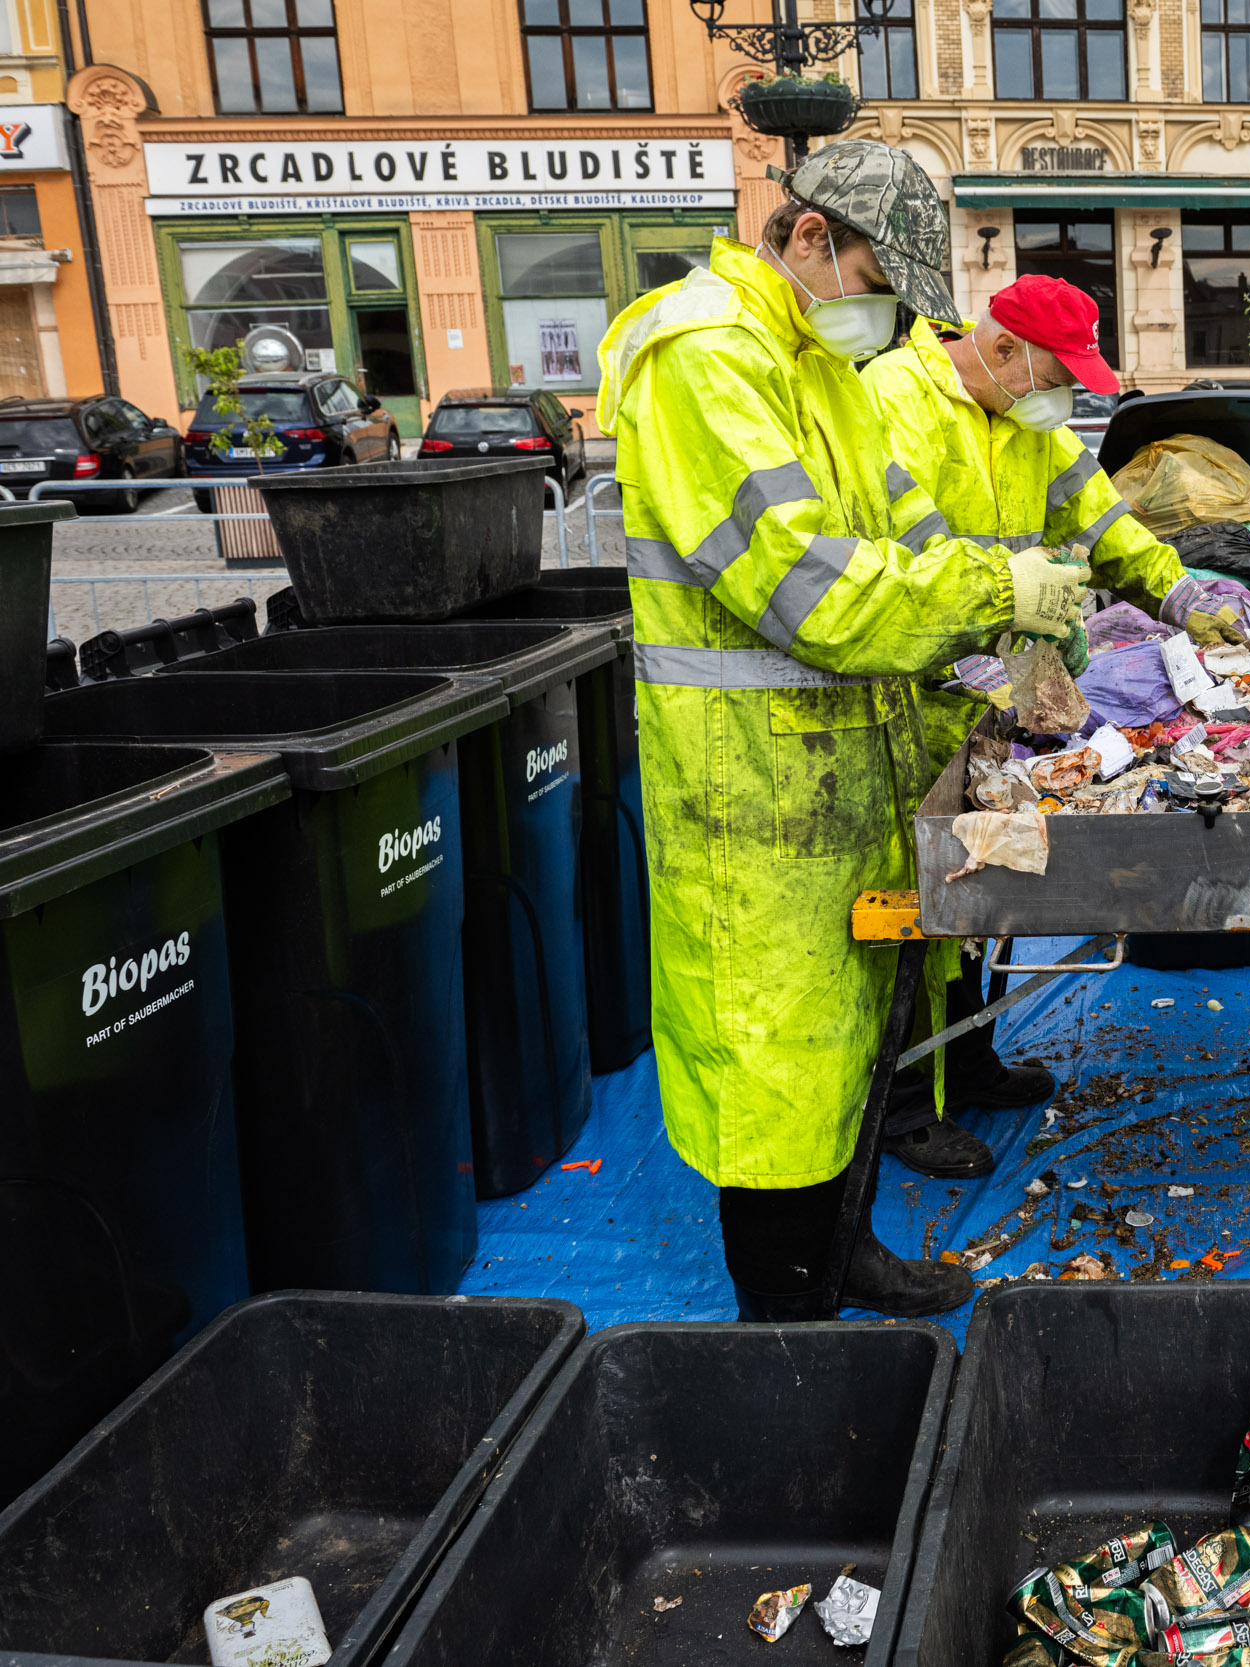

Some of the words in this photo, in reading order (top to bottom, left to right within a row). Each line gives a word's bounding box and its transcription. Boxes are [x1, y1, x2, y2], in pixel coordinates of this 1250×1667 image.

[185, 143, 458, 184] ZRCADLOVÉ
[487, 142, 705, 181] BLUDIŠTĚ
[180, 198, 243, 211] ZRCADLOVÉ
[247, 197, 303, 210] BLUDIŠTĚ,
[377, 194, 432, 209] BLUDIŠTĚ,
[436, 193, 470, 207] KŘIVÁ
[475, 194, 526, 208] ZRCADLA,
[530, 193, 568, 206] DĚTSKÉ
[574, 192, 626, 206] BLUDIŠTĚ,
[631, 193, 703, 205] KALEIDOSKOP
[526, 738, 568, 783] Biopas
[378, 815, 441, 873] Biopas
[381, 882, 396, 898] PART
[396, 878, 404, 889] OF
[405, 854, 444, 884] SAUBERMACHER
[82, 931, 190, 1017] Biopas
[86, 1026, 111, 1048] PART
[113, 1018, 126, 1033] OF
[128, 980, 195, 1025] SAUBERMACHER
